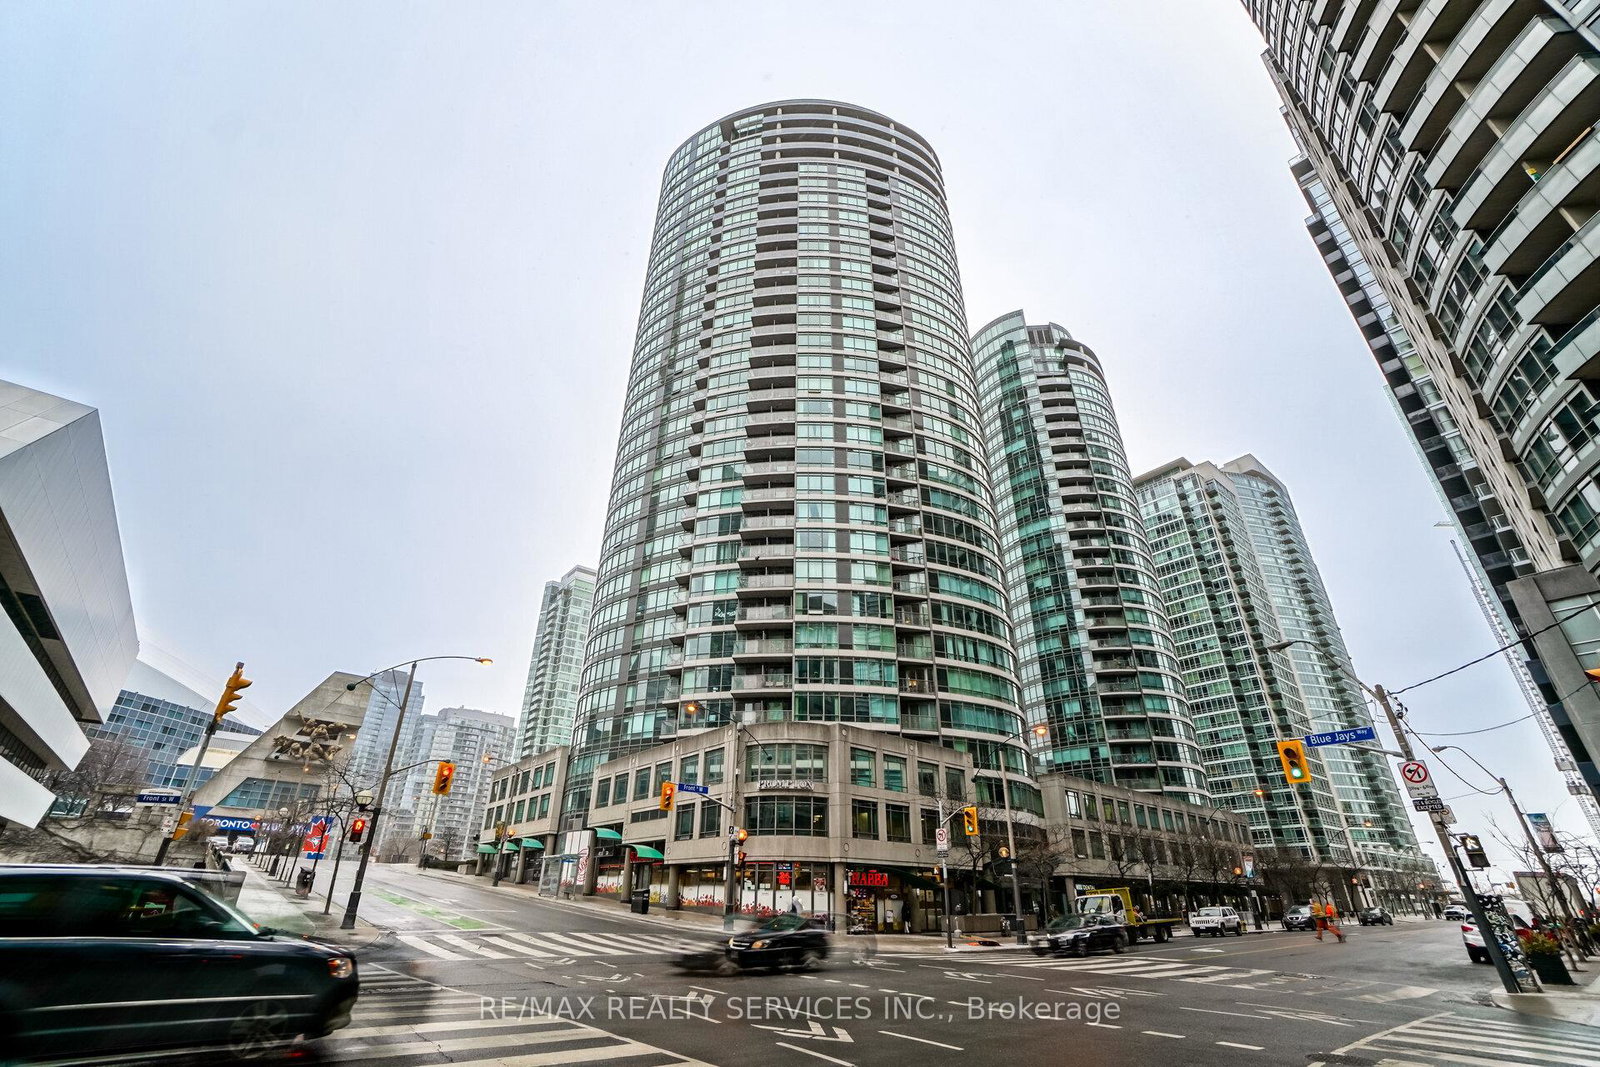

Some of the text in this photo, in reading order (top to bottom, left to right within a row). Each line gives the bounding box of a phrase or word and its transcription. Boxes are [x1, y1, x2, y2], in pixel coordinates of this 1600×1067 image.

[1310, 734, 1332, 745] Blue
[1335, 731, 1356, 742] Jays
[201, 818, 250, 829] TORONTO
[850, 872, 889, 887] RABBA
